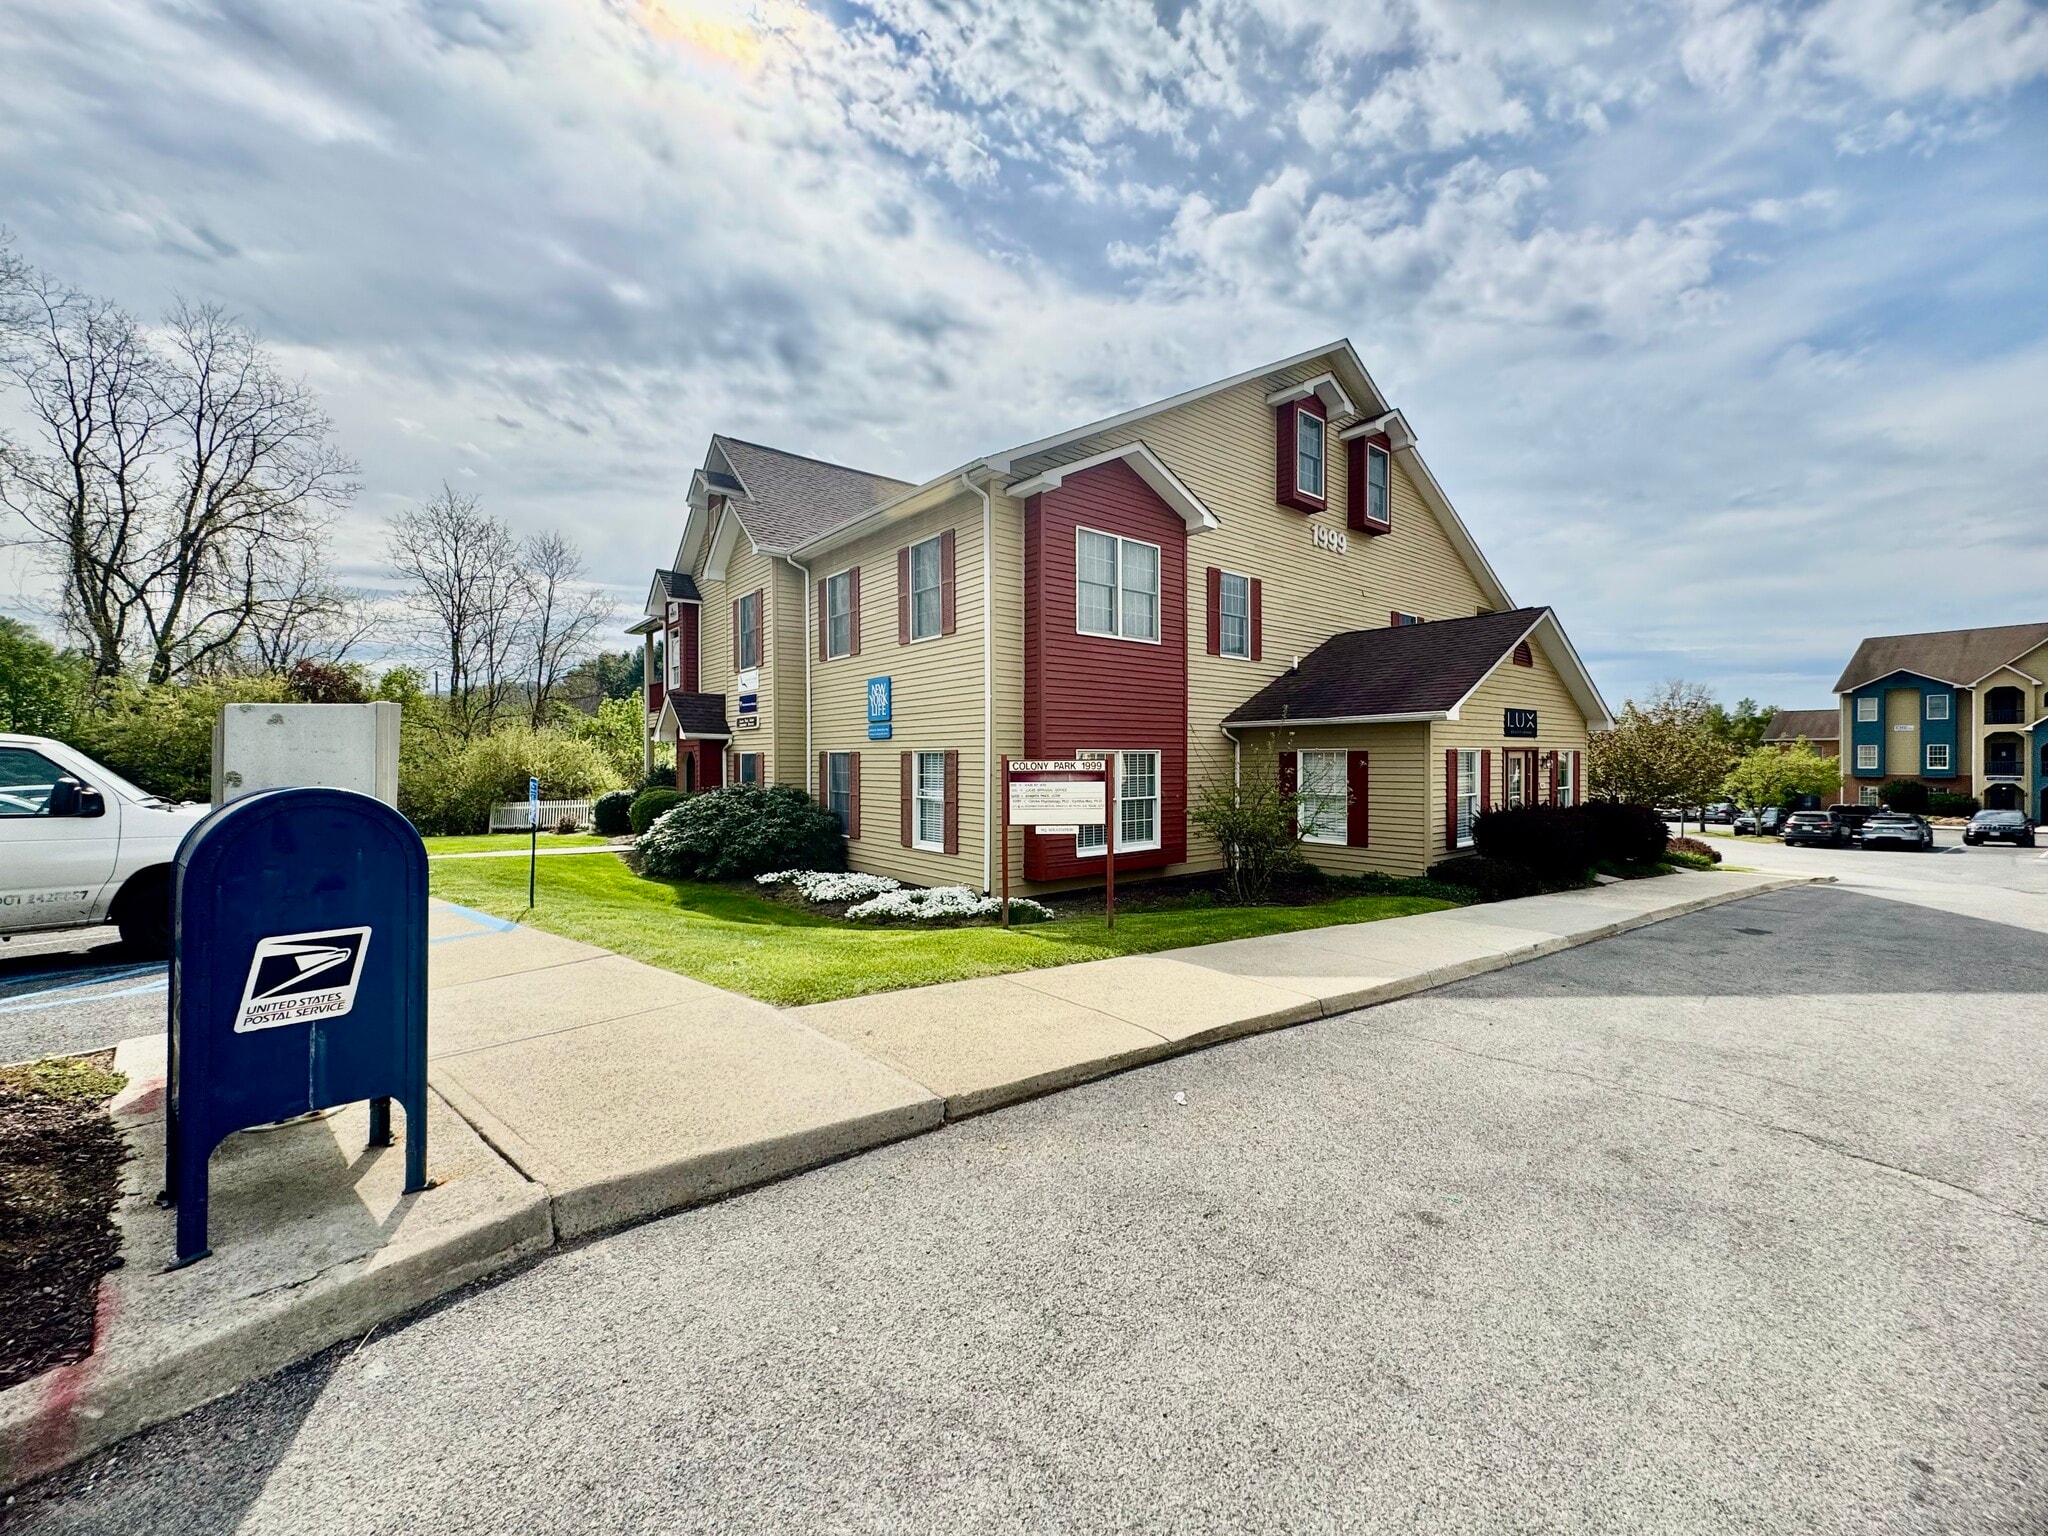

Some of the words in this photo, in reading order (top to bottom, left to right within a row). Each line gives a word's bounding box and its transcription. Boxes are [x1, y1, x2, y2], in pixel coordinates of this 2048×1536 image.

[1311, 524, 1347, 555] 1999
[871, 683, 886, 696] NEW
[869, 693, 889, 706] YORK
[871, 704, 886, 716] LIFE
[1507, 711, 1535, 728] LUX
[1012, 762, 1049, 770] COLONY
[1053, 762, 1076, 770] PARK
[1082, 762, 1102, 770] 1999
[0, 894, 21, 906] OT
[246, 999, 296, 1014] UNITED
[298, 992, 341, 1006] STATES
[243, 1010, 291, 1026] POSTAL
[296, 1002, 345, 1017] SERVICE
